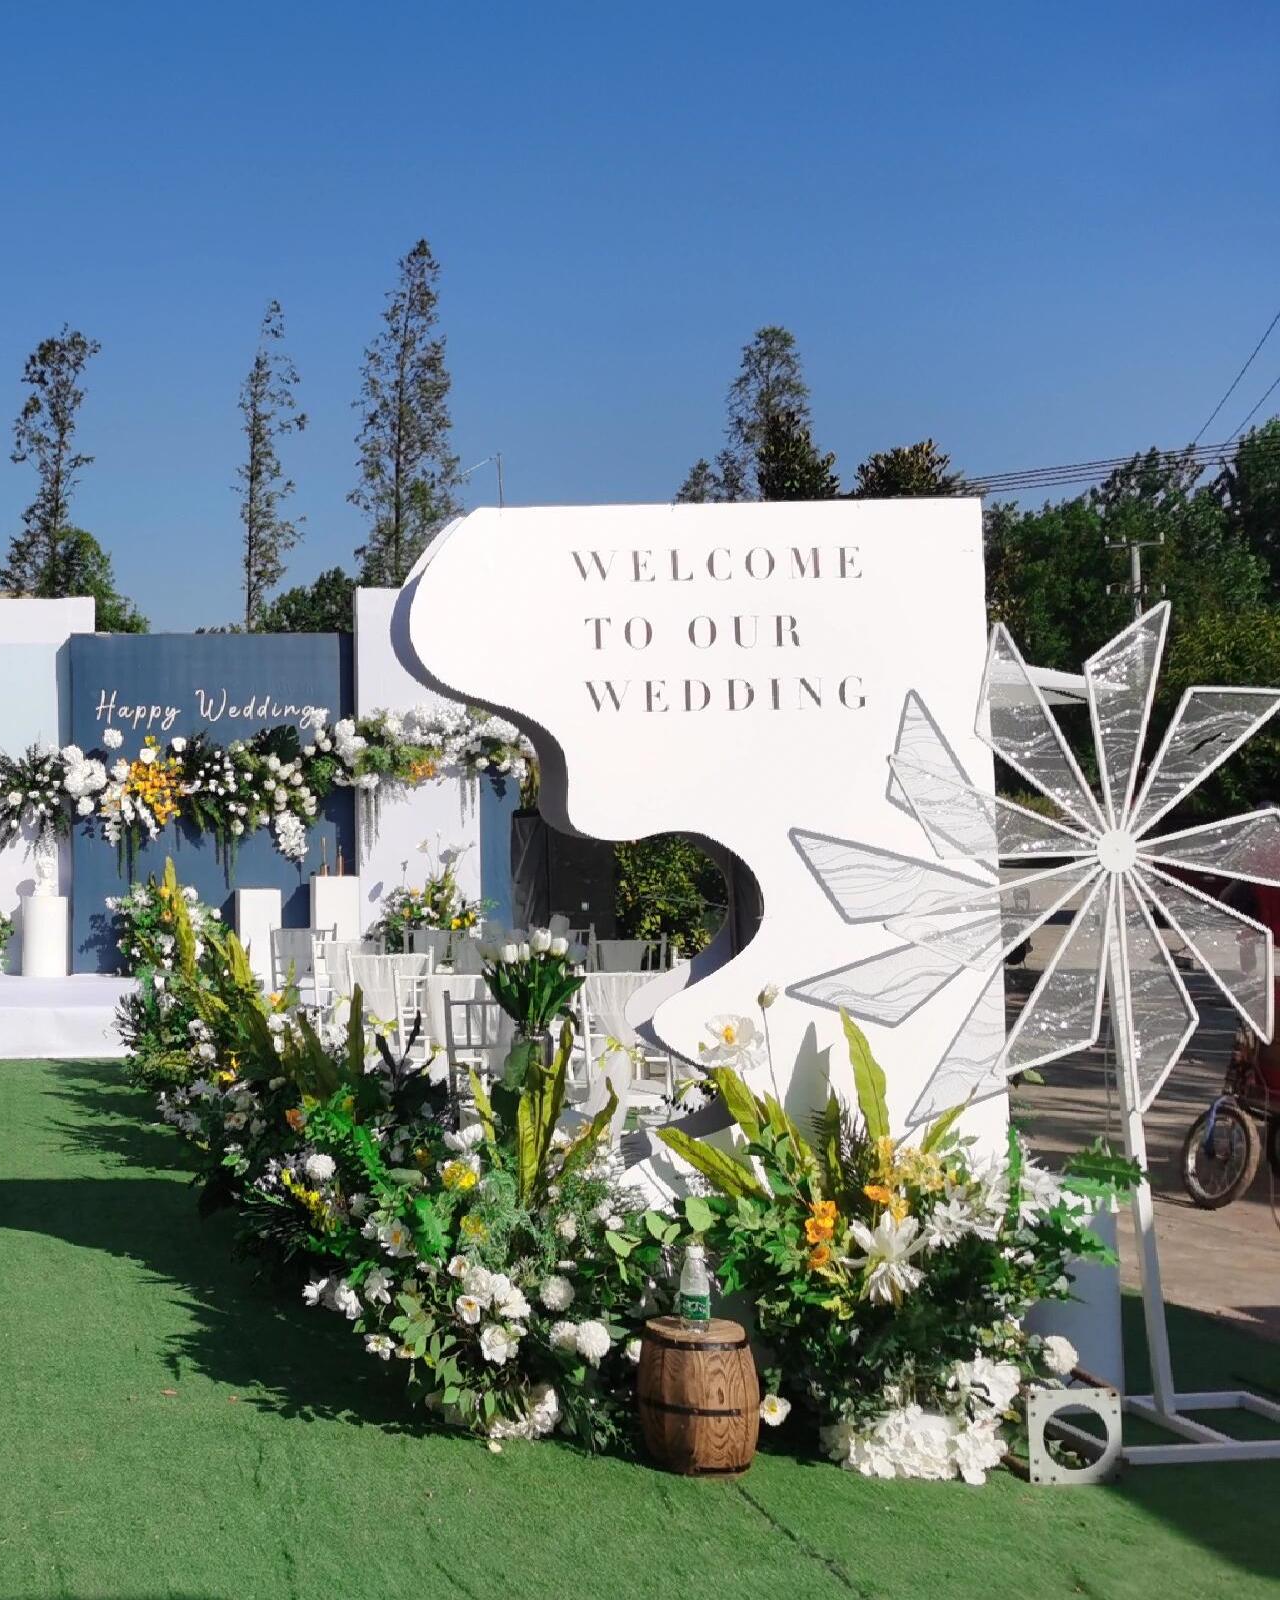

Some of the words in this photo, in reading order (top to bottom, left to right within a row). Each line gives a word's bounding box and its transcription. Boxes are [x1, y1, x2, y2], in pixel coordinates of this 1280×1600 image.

[569, 547, 863, 582] WELCOME
[584, 616, 653, 651] TO
[688, 614, 801, 649] OUR
[95, 688, 182, 731] Happy
[194, 687, 327, 730] Wedding
[582, 675, 869, 713] WEDDING
